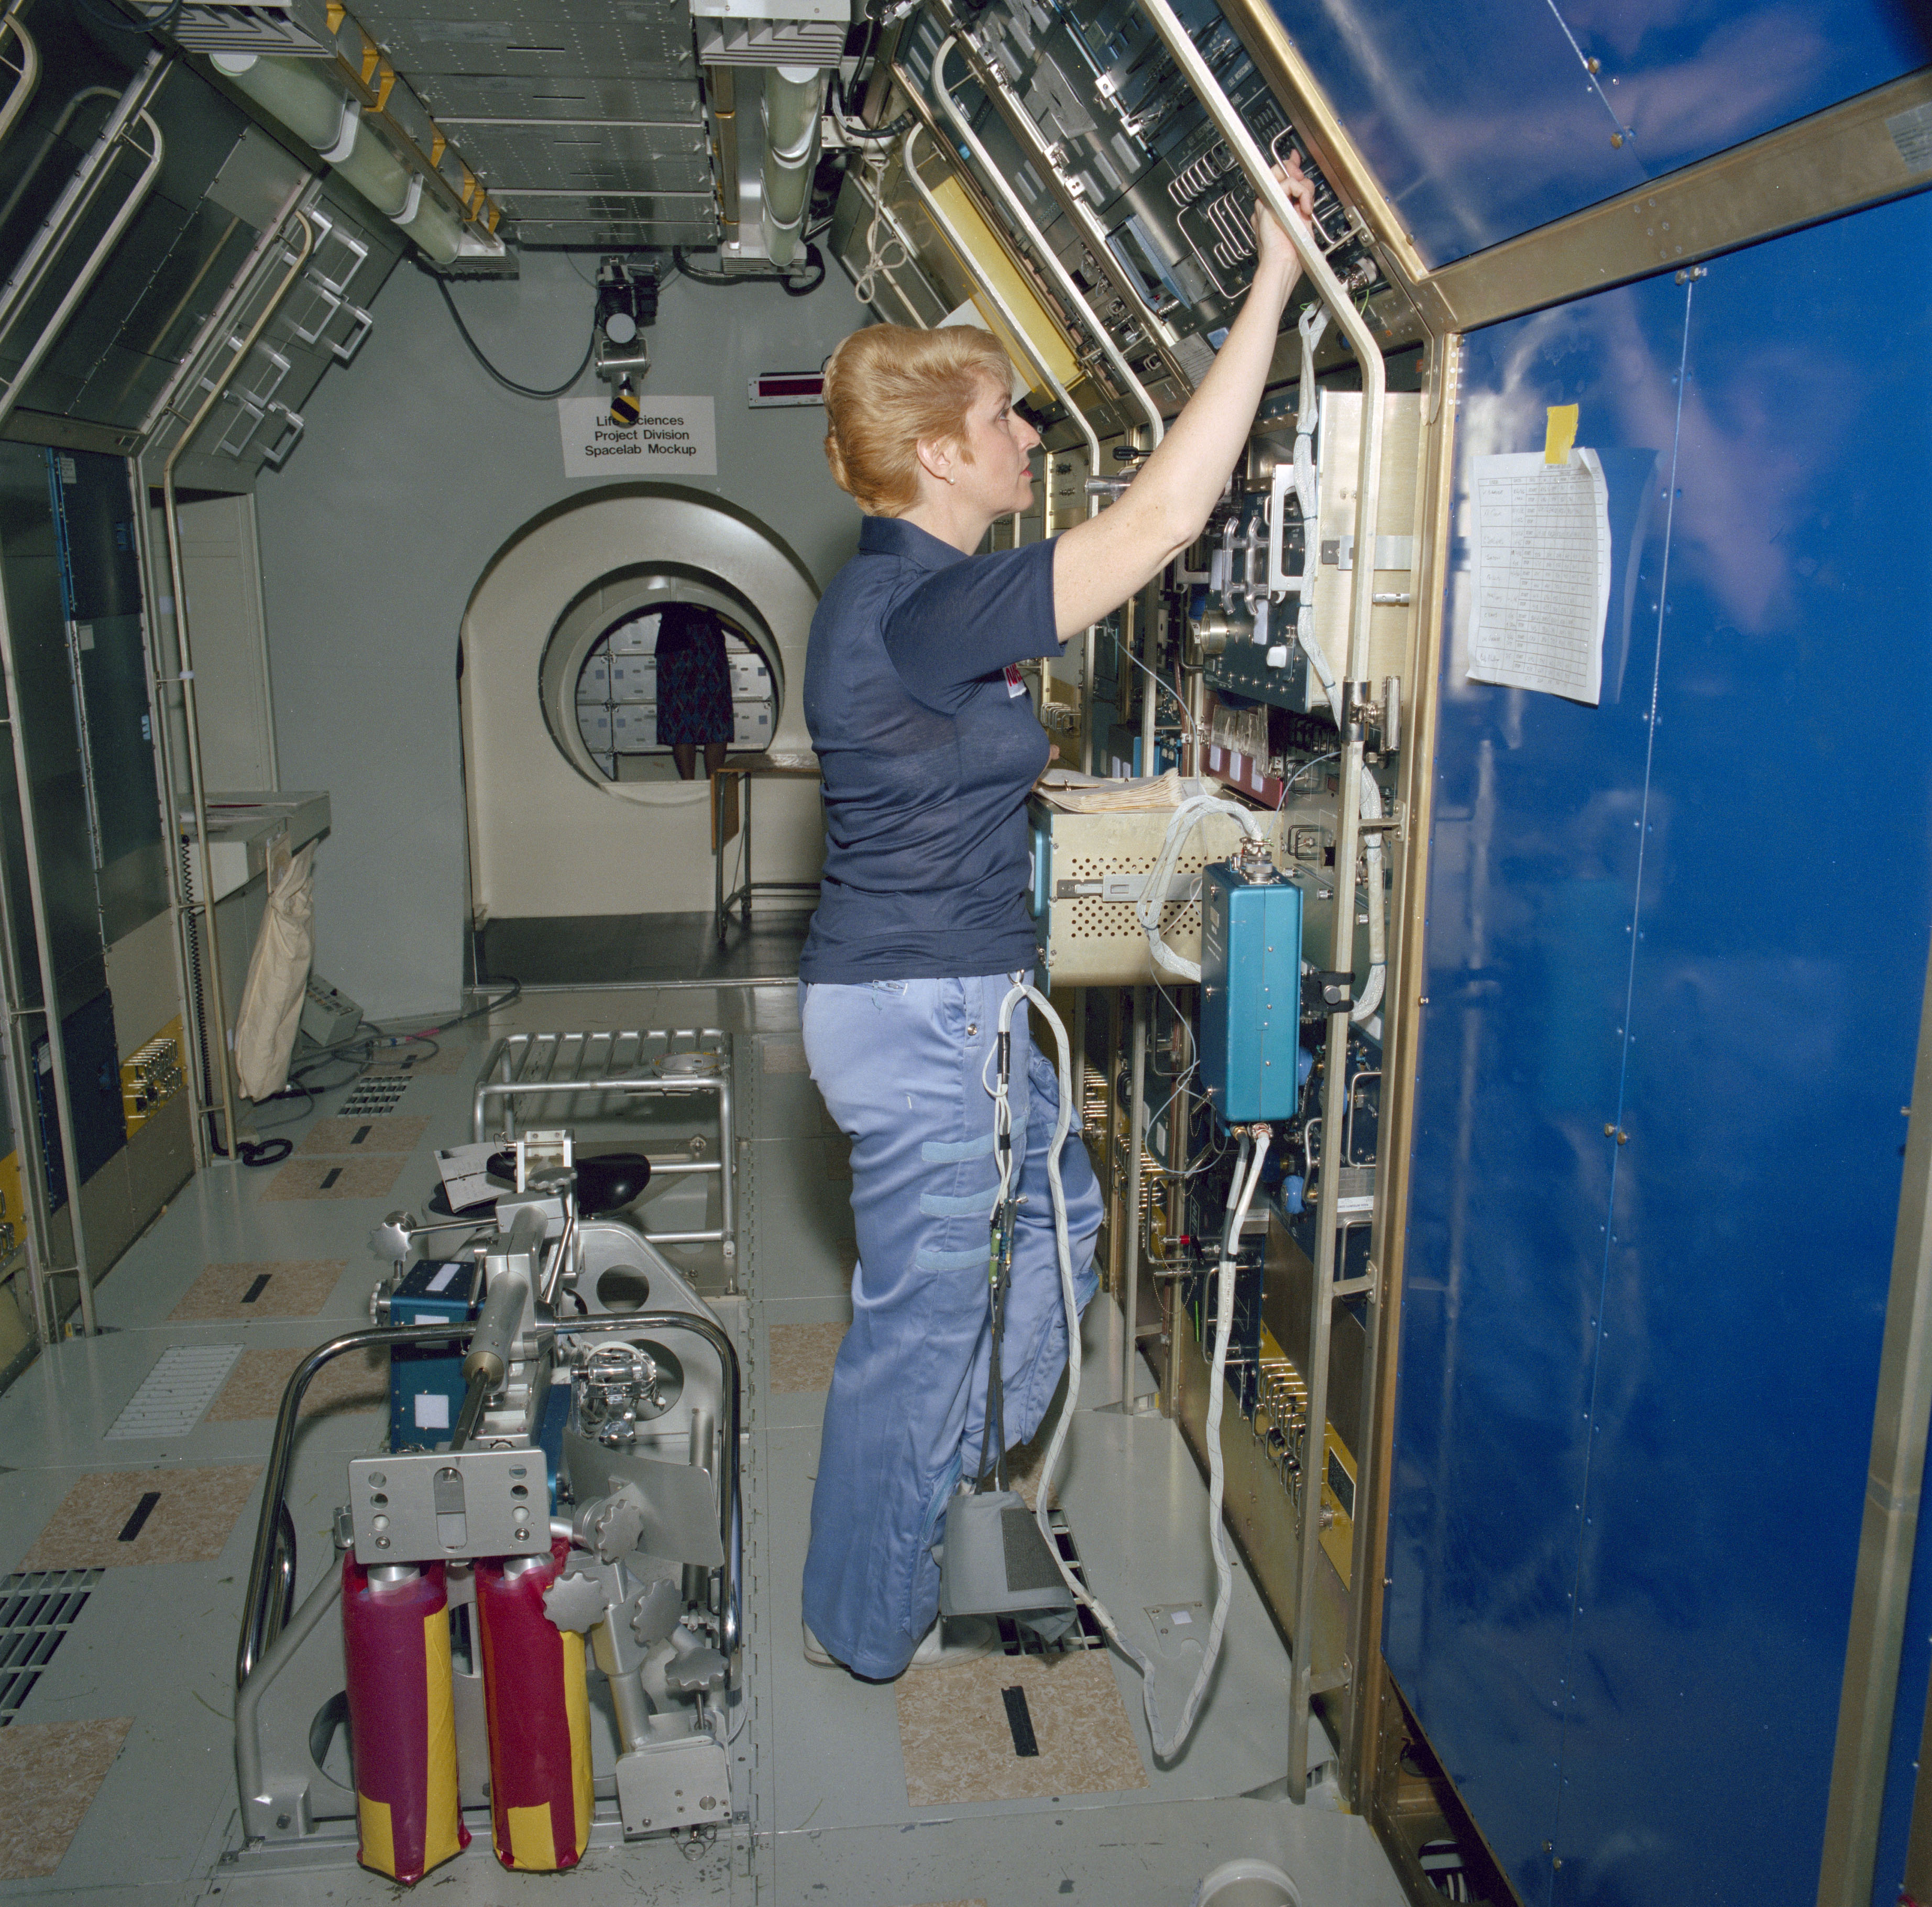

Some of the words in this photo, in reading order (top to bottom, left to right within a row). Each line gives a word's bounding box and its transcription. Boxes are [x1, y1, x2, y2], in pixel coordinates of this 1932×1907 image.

[596, 415, 620, 426] Life
[595, 430, 638, 442] Project
[643, 429, 689, 440] Division
[585, 444, 642, 457] Spacelab
[648, 444, 697, 456] Mockup
